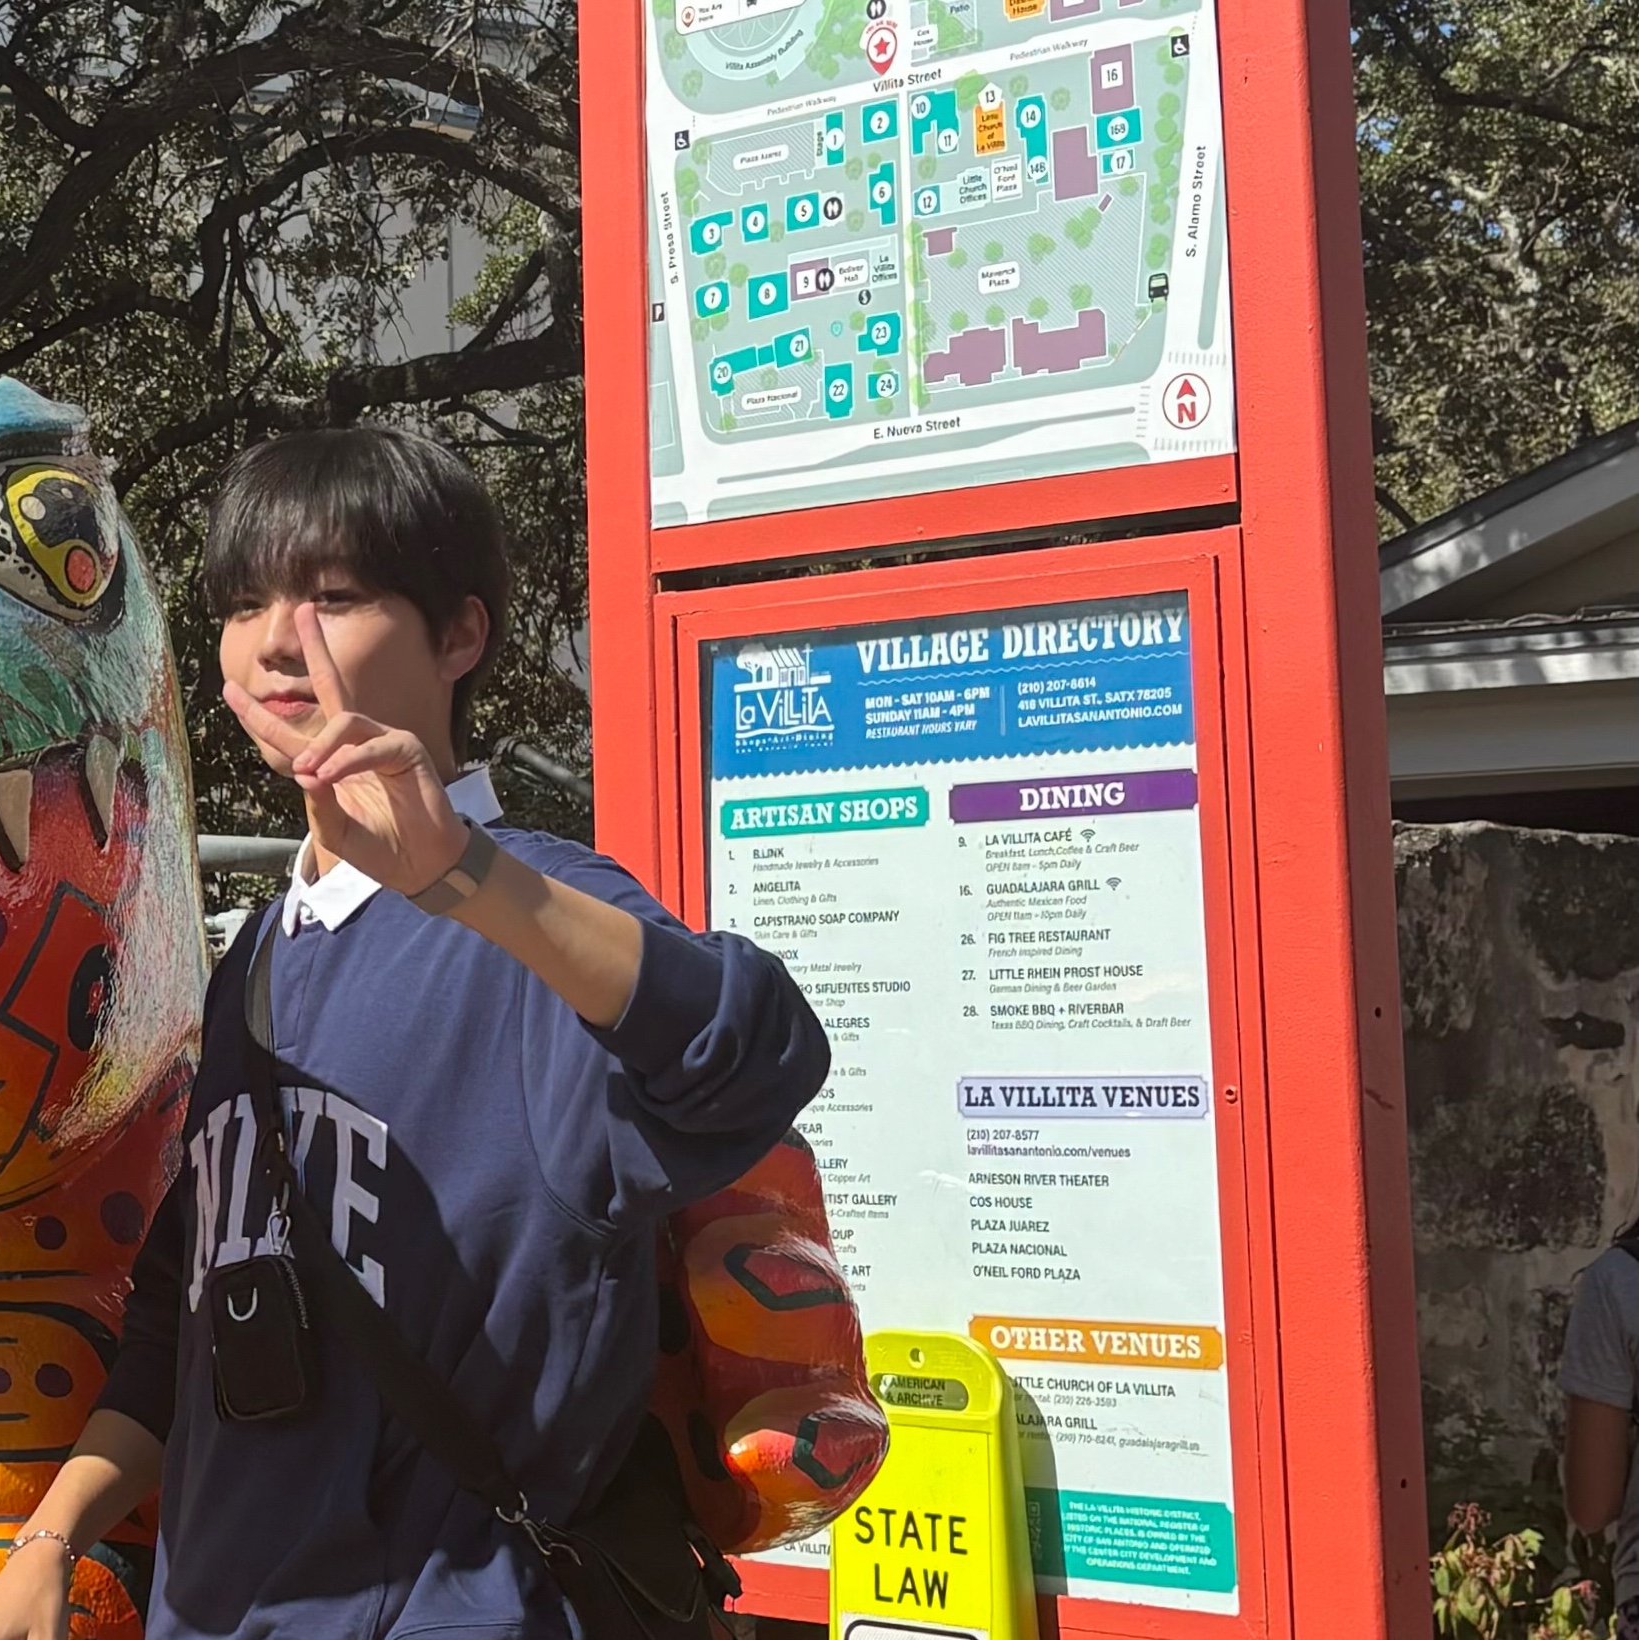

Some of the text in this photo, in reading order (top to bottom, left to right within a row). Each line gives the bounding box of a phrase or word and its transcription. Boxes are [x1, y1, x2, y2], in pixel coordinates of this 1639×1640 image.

[873, 68, 942, 92] Villita Street
[1107, 68, 1118, 82] 16
[985, 90, 996, 102] 13
[916, 102, 926, 114] 10
[1026, 110, 1036, 122] 14
[877, 117, 883, 129] 2
[944, 134, 952, 147] 11
[1116, 156, 1126, 168] 17
[1190, 145, 1206, 191] Street
[963, 174, 982, 186] Little
[879, 186, 885, 198] 6
[959, 183, 988, 196] Church
[922, 197, 932, 208] 12
[960, 192, 987, 204] Offices
[801, 205, 807, 217] 5
[1187, 194, 1202, 240] Alamo
[752, 216, 758, 227] 4
[709, 227, 714, 240] 3
[803, 276, 809, 288] 9
[710, 293, 715, 304] 7
[875, 327, 887, 339] 23
[795, 340, 804, 352] 21
[717, 365, 729, 379] 20
[833, 384, 845, 397] 22
[880, 379, 892, 392] 24
[1177, 401, 1196, 423] N
[873, 416, 961, 439] E. Nueva Street
[857, 610, 1186, 674] VILLAGE DIRECTORY
[1018, 682, 1044, 695] (210)
[865, 696, 893, 709] MON
[901, 693, 923, 705] SAT
[925, 690, 955, 703] 10AM
[964, 687, 990, 700] 6PM
[1038, 695, 1080, 709] VILLITA
[1105, 691, 1135, 704] SATX
[1137, 687, 1172, 700] 78205
[865, 710, 912, 725] SUNDAY
[914, 707, 940, 720] 11AM
[949, 704, 975, 716] 4PM
[1018, 704, 1182, 728] LAVILLITASANANTONIO.COM
[1019, 783, 1125, 811] DINING
[730, 796, 918, 830] ARTISAN SHOPS
[958, 828, 1072, 848] 9. LA VILLITA CAFÉ
[729, 881, 801, 894] 2. ANGELITA
[959, 879, 1100, 896] 16. GUADALAJARA GRILL
[754, 910, 900, 928] CAPISTRANO SOAP COMPANY
[961, 929, 1111, 945] 26. FIG TREE RESTAURANT
[962, 965, 1143, 981] 27. LITTLE RHEIN PROST HOUSE
[815, 981, 911, 994] SIFUENTES STUDIO
[963, 1006, 979, 1017] 28.
[990, 1004, 1030, 1017] SMOKE
[1032, 1004, 1055, 1017] BBQ
[1068, 1003, 1124, 1015] RIVERBAR
[824, 1018, 870, 1028] ALEGRES
[965, 1086, 1200, 1108] LA VILLITA VENUES
[966, 1129, 1039, 1142] (210) 207-8577
[967, 1144, 1131, 1158] lavillitasanantonio.com/venues
[968, 1173, 1109, 1186] ARNESON RIVER THEATER
[852, 1195, 897, 1205] GALLERY
[969, 1196, 1032, 1208] COS HOUSE
[970, 1220, 1050, 1232] PLAZA JUAREZ
[972, 1242, 1068, 1256] PLAZA NACIONAL
[852, 1266, 871, 1276] ART
[973, 1265, 1080, 1281] O'NEIL FORD PLAZA
[990, 1325, 1202, 1359] OTHER VENUES
[1047, 1378, 1094, 1392] CHURCH
[1097, 1381, 1112, 1393] OF
[1116, 1382, 1130, 1394] LA
[1133, 1383, 1176, 1397] VILLITA
[1065, 1417, 1097, 1430] GRILL
[855, 1506, 968, 1555] STATE
[874, 1563, 949, 1610] LAW
